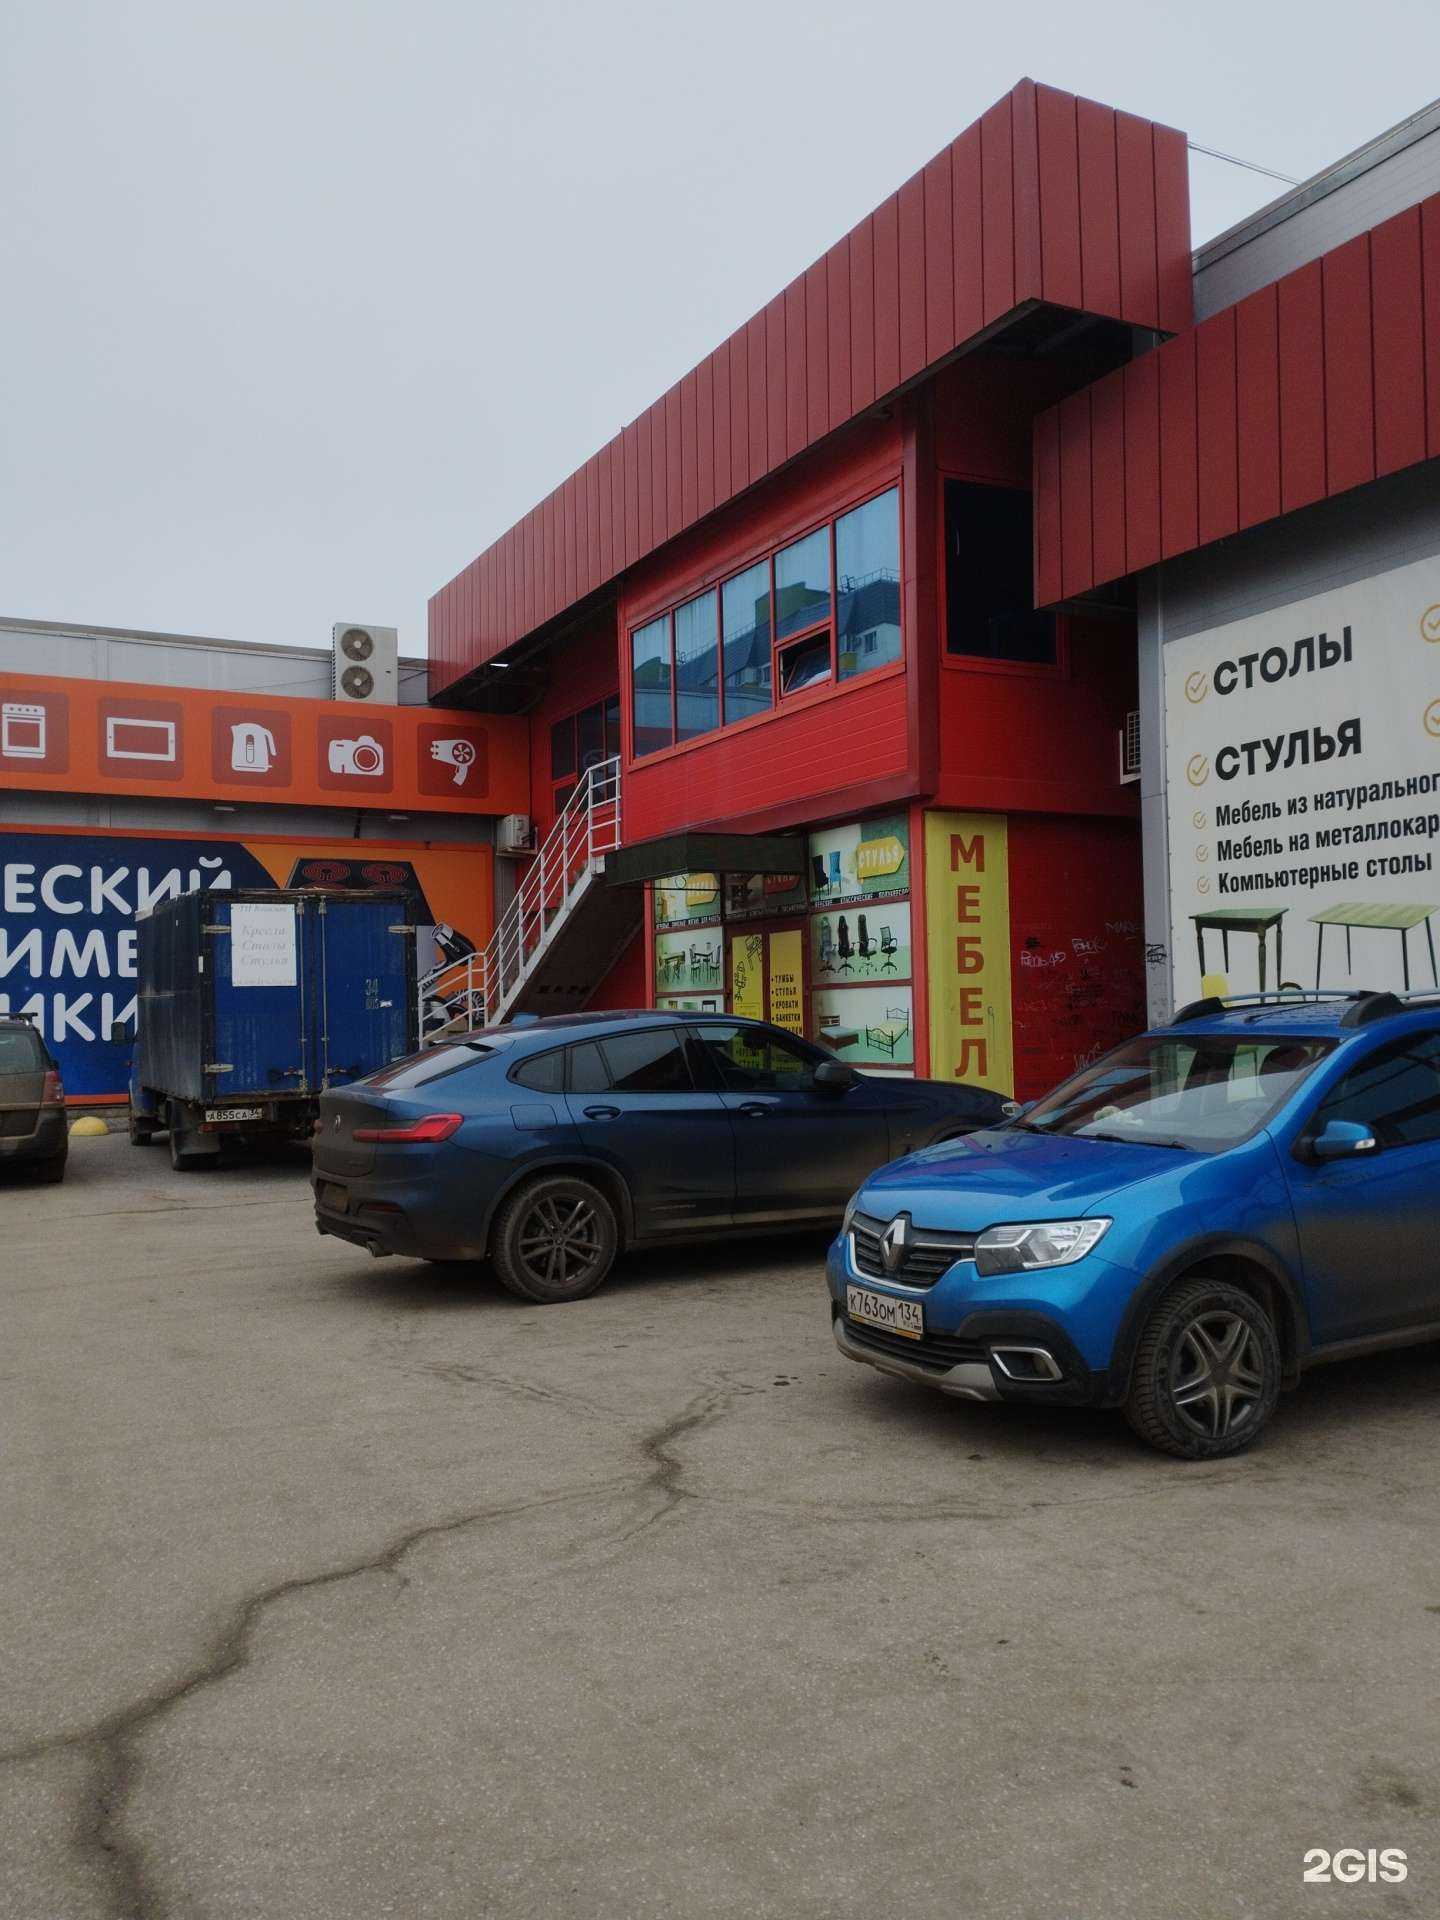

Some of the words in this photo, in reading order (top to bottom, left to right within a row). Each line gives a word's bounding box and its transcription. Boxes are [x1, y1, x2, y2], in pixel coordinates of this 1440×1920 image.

[1213, 626, 1353, 695] СТОЛЫ
[1215, 718, 1362, 781] СТУЛЬЯ
[1216, 800, 1282, 827] Мебель
[1287, 796, 1308, 816] из
[1217, 836, 1283, 862] Мебель
[1289, 832, 1310, 852] на
[1315, 813, 1440, 849] металлокар
[1218, 860, 1359, 890] Компьютерные
[1366, 852, 1433, 878] столы
[775, 999, 799, 1010] КРОВАТИ
[776, 1013, 801, 1023] БАНКЕТКИ
[849, 1291, 896, 1324] К763ОМ
[897, 1302, 919, 1323] 134
